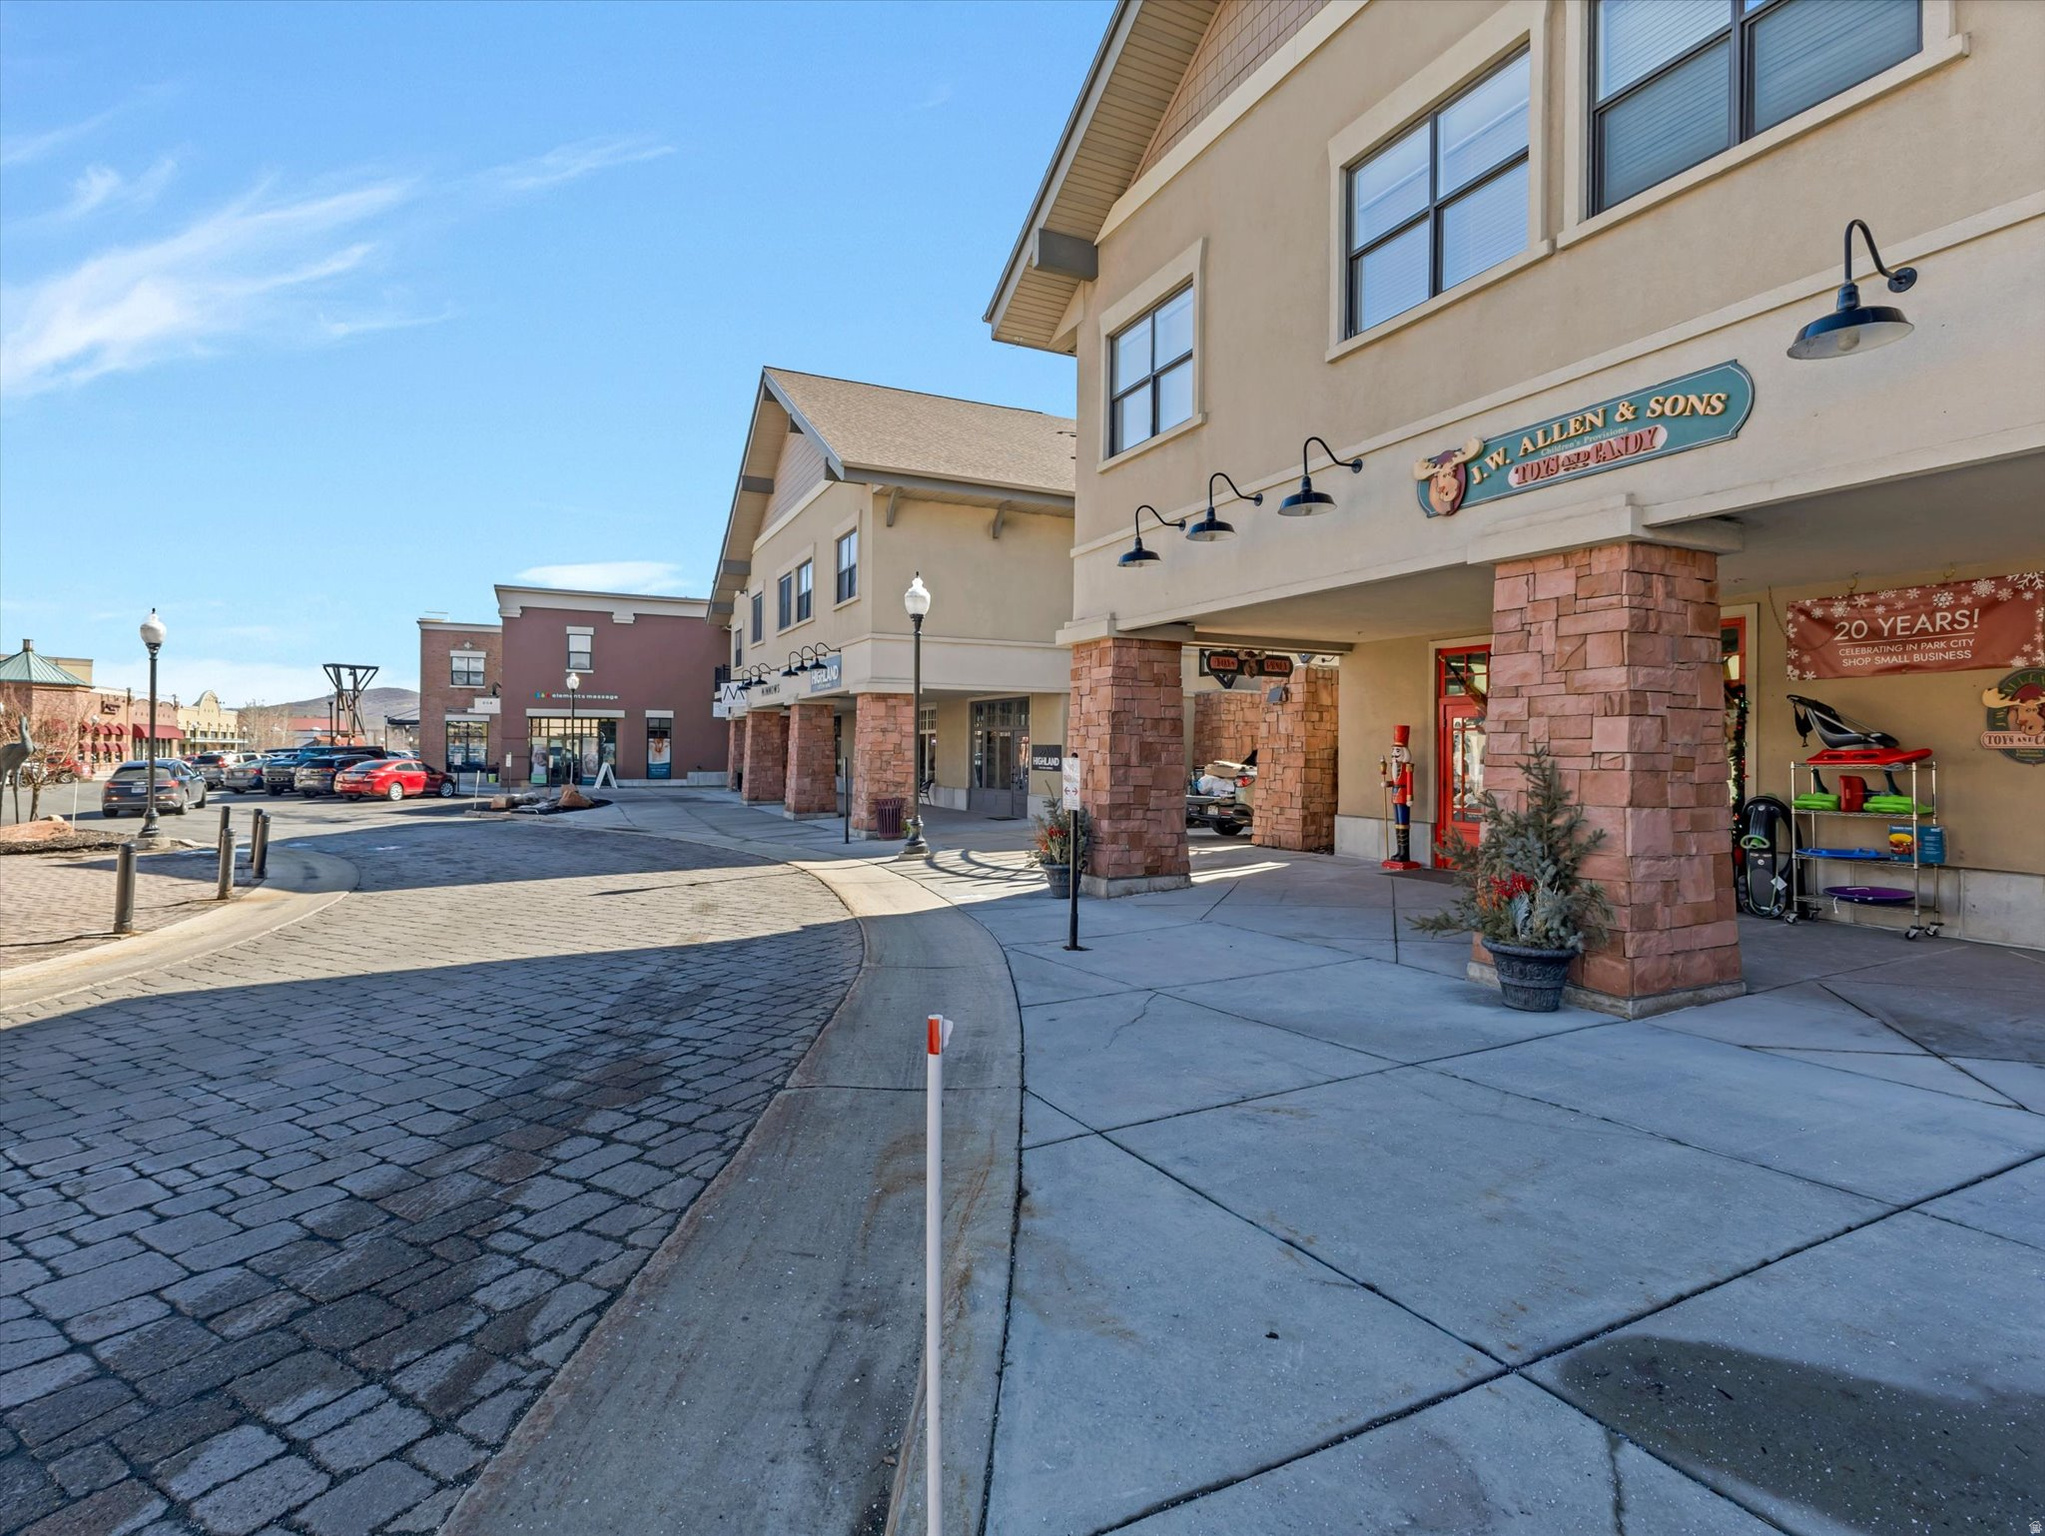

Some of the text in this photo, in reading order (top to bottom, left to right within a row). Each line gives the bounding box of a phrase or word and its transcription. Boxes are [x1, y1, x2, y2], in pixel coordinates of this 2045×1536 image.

[1470, 393, 1728, 485] J. W. ALLEN & SONS
[1540, 426, 1628, 457] Children's Provisions
[1514, 453, 1560, 485] TOYS
[1590, 426, 1659, 464] CANDY
[1834, 608, 1979, 641] 20 YEARS!
[1839, 639, 1975, 656] CELEBRATING IN PARK CITY
[1842, 650, 1972, 667] SHOP SMALL BUSINESS
[1985, 735, 2014, 745] TOYS
[1032, 757, 1060, 766] HIGHLAND
